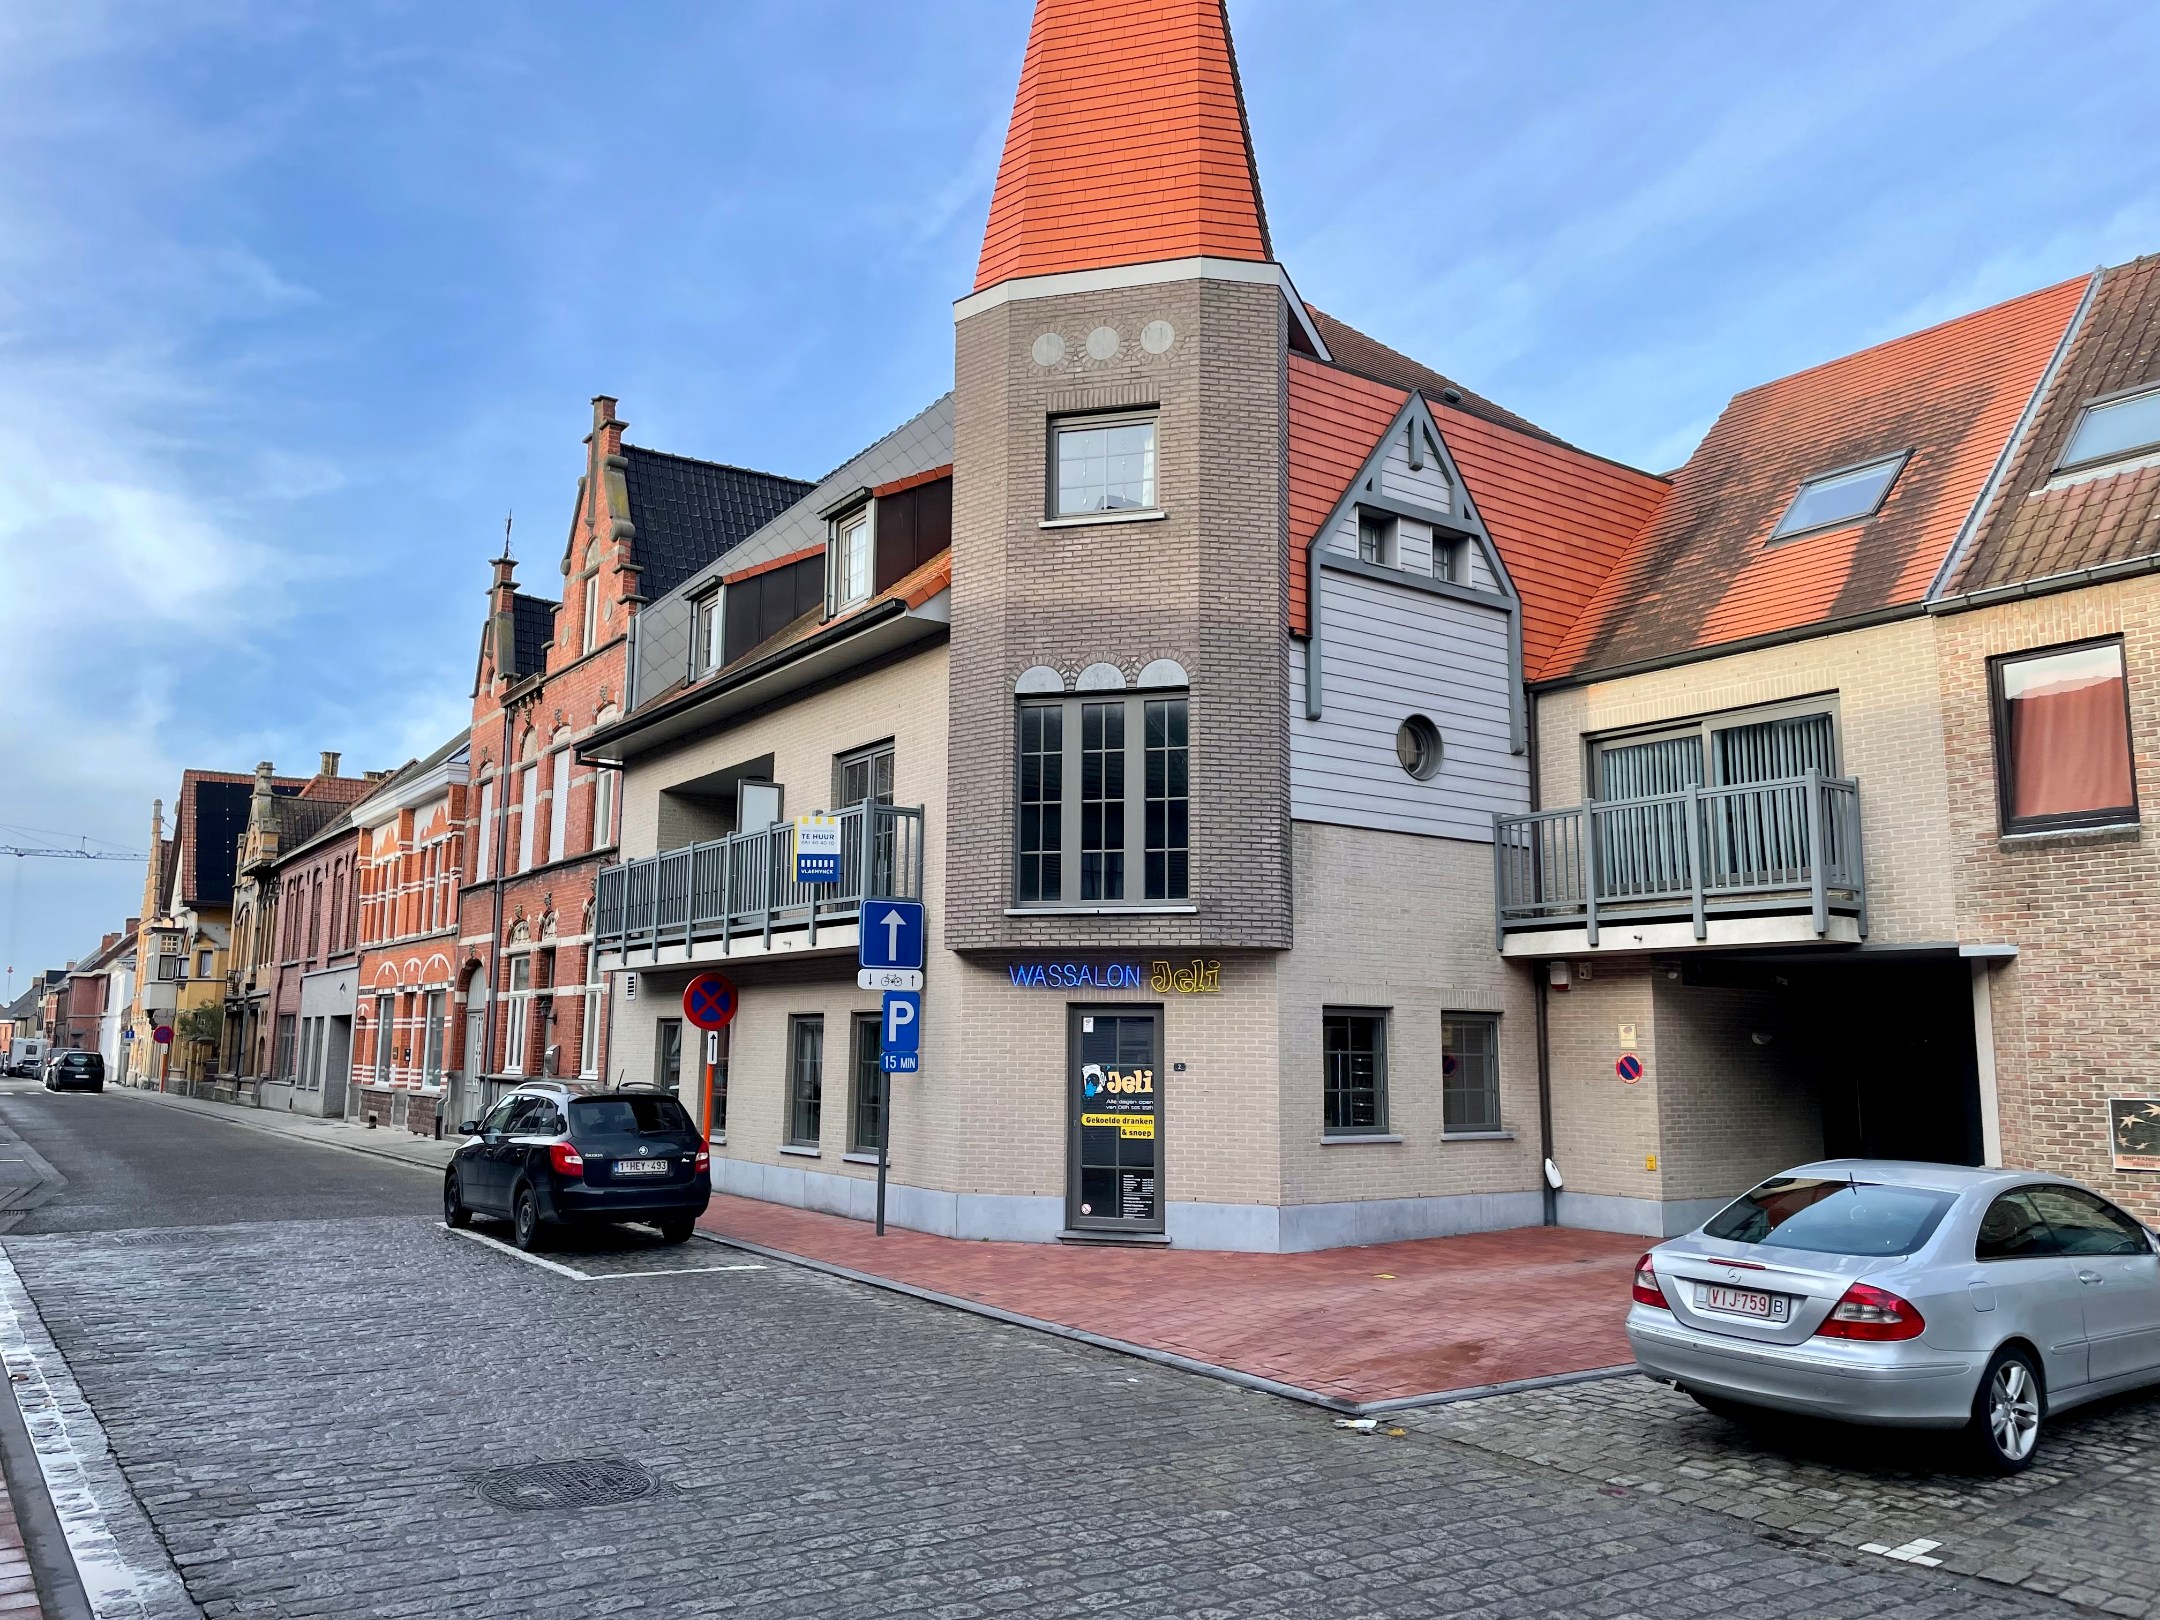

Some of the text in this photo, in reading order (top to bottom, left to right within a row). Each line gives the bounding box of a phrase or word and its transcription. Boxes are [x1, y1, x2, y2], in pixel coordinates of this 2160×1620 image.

[1009, 959, 1221, 993] WASSALON Jeli
[888, 1000, 914, 1042] P
[885, 1055, 916, 1069] 15 MIN
[1106, 1069, 1154, 1094] Jeli
[1086, 1116, 1153, 1125] Gekoelde dranken
[1128, 1130, 1152, 1138] snoep
[1773, 1300, 1783, 1313] B
